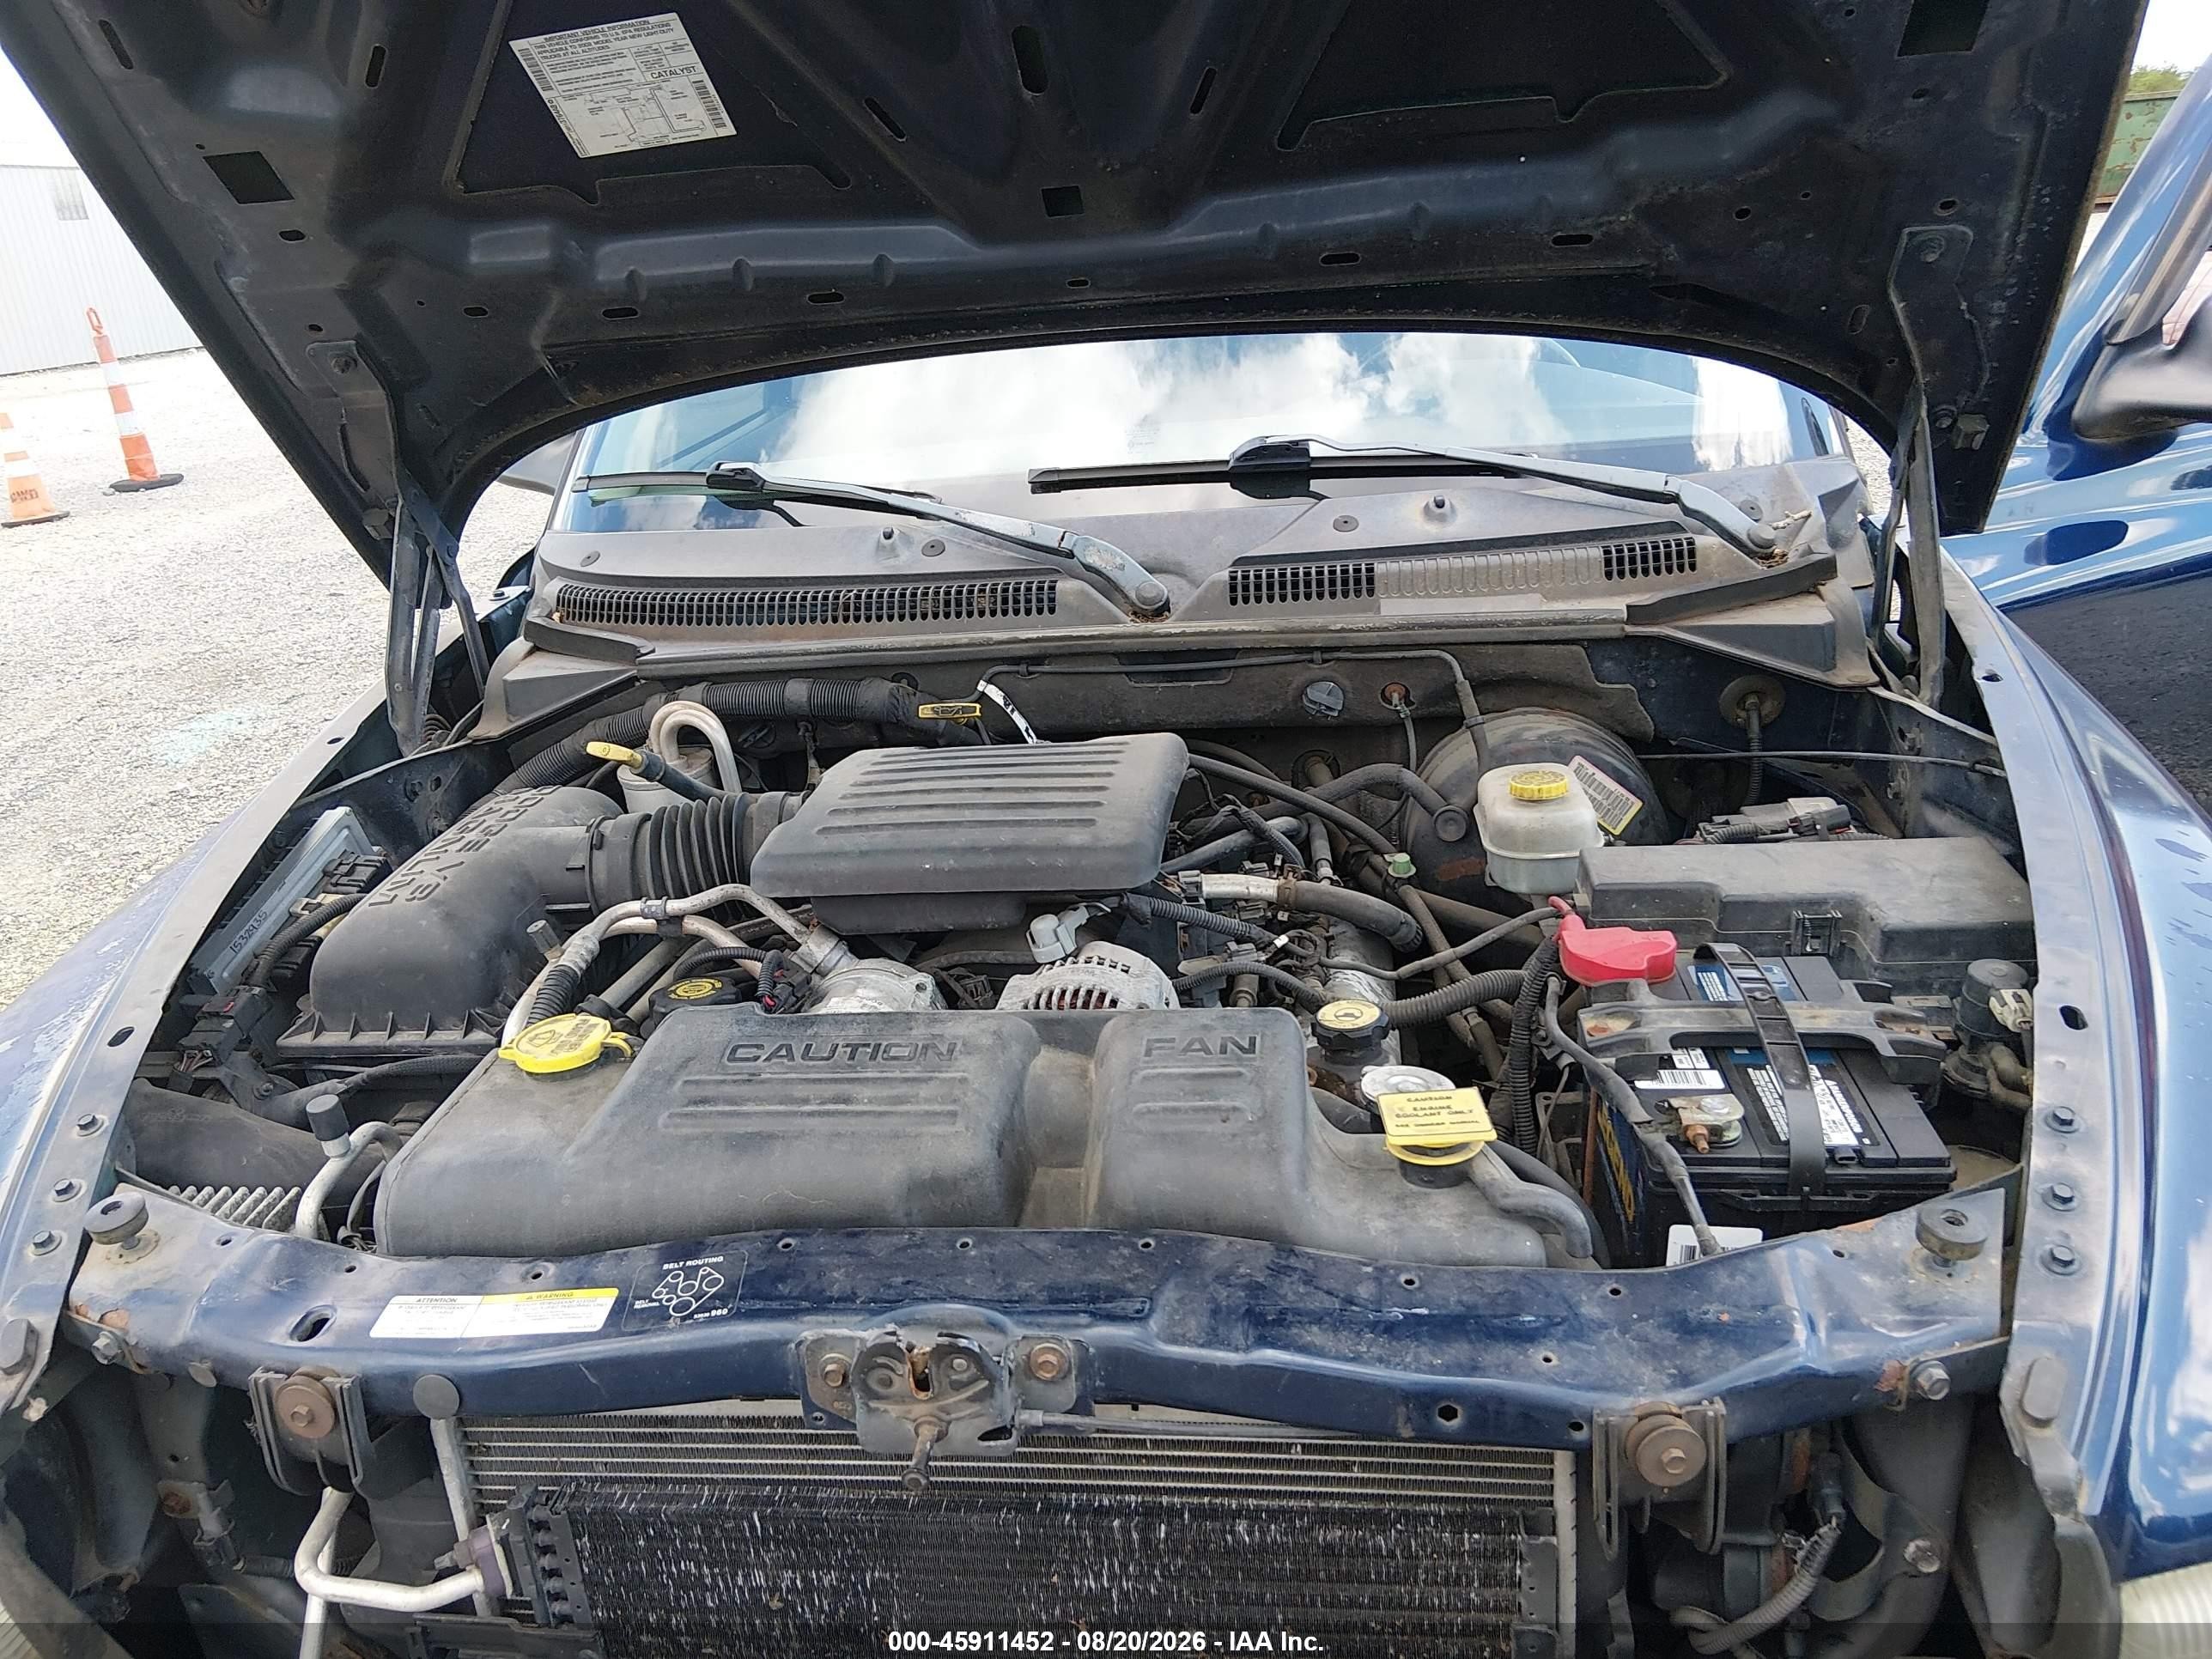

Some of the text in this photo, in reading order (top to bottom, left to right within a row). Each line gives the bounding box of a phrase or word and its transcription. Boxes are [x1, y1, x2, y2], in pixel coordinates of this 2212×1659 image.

[544, 20, 651, 42] IMPORTANT VEHICLE INFORMATION
[569, 34, 600, 44] CONFORMS
[634, 22, 672, 33] REGULATIONS
[650, 65, 697, 79] CATALYST
[404, 785, 563, 902] DODGE V8
[725, 1034, 1259, 1064] CAUTION FAN
[662, 1255, 724, 1270] BELT ROUTING
